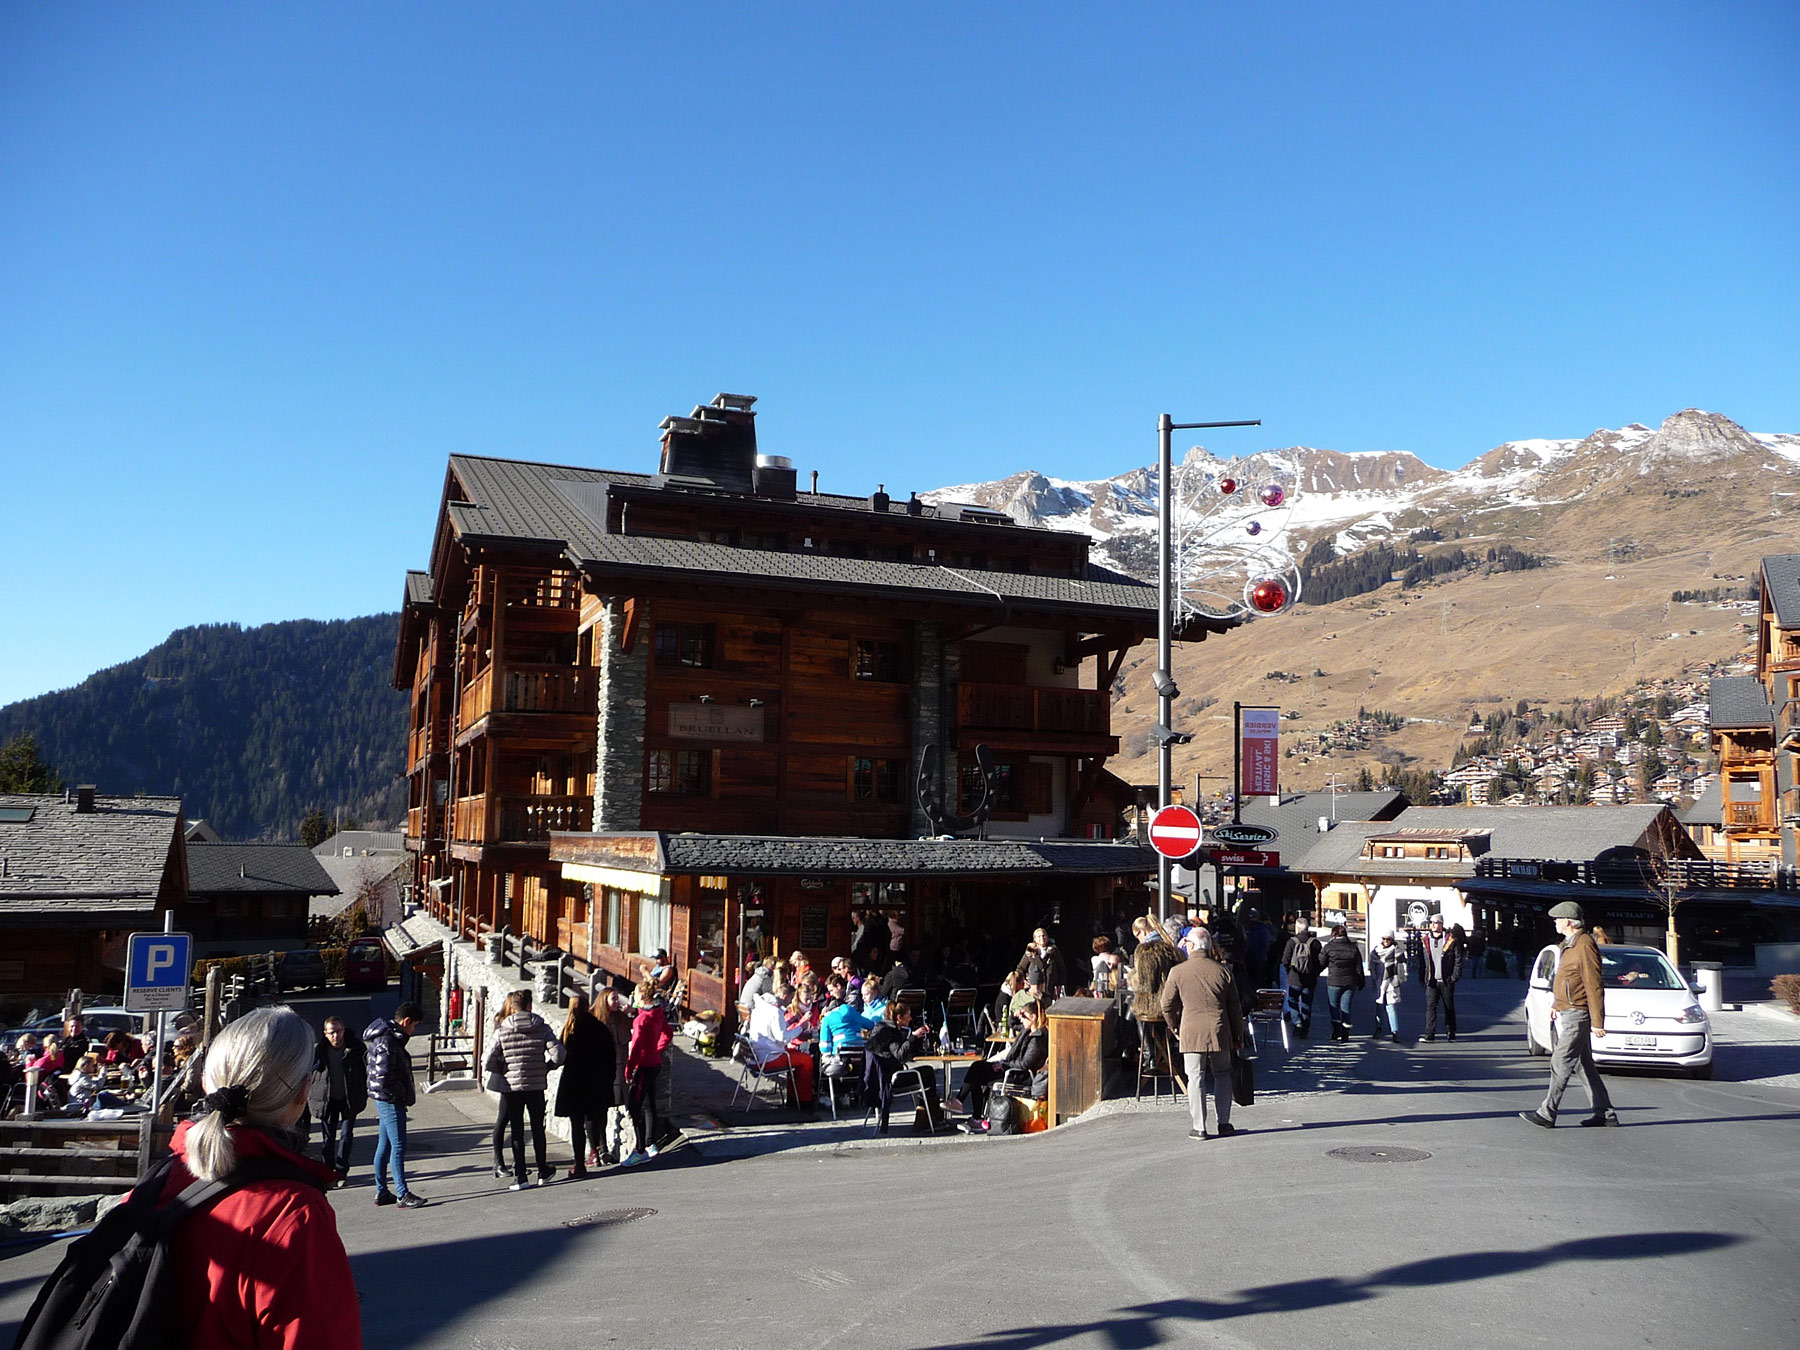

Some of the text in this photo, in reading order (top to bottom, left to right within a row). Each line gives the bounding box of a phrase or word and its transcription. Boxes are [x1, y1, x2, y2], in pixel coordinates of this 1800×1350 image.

[679, 724, 755, 736] BRUELLAN
[1220, 853, 1245, 862] swiss
[1605, 911, 1655, 919] MICHAUD
[146, 944, 175, 982] P
